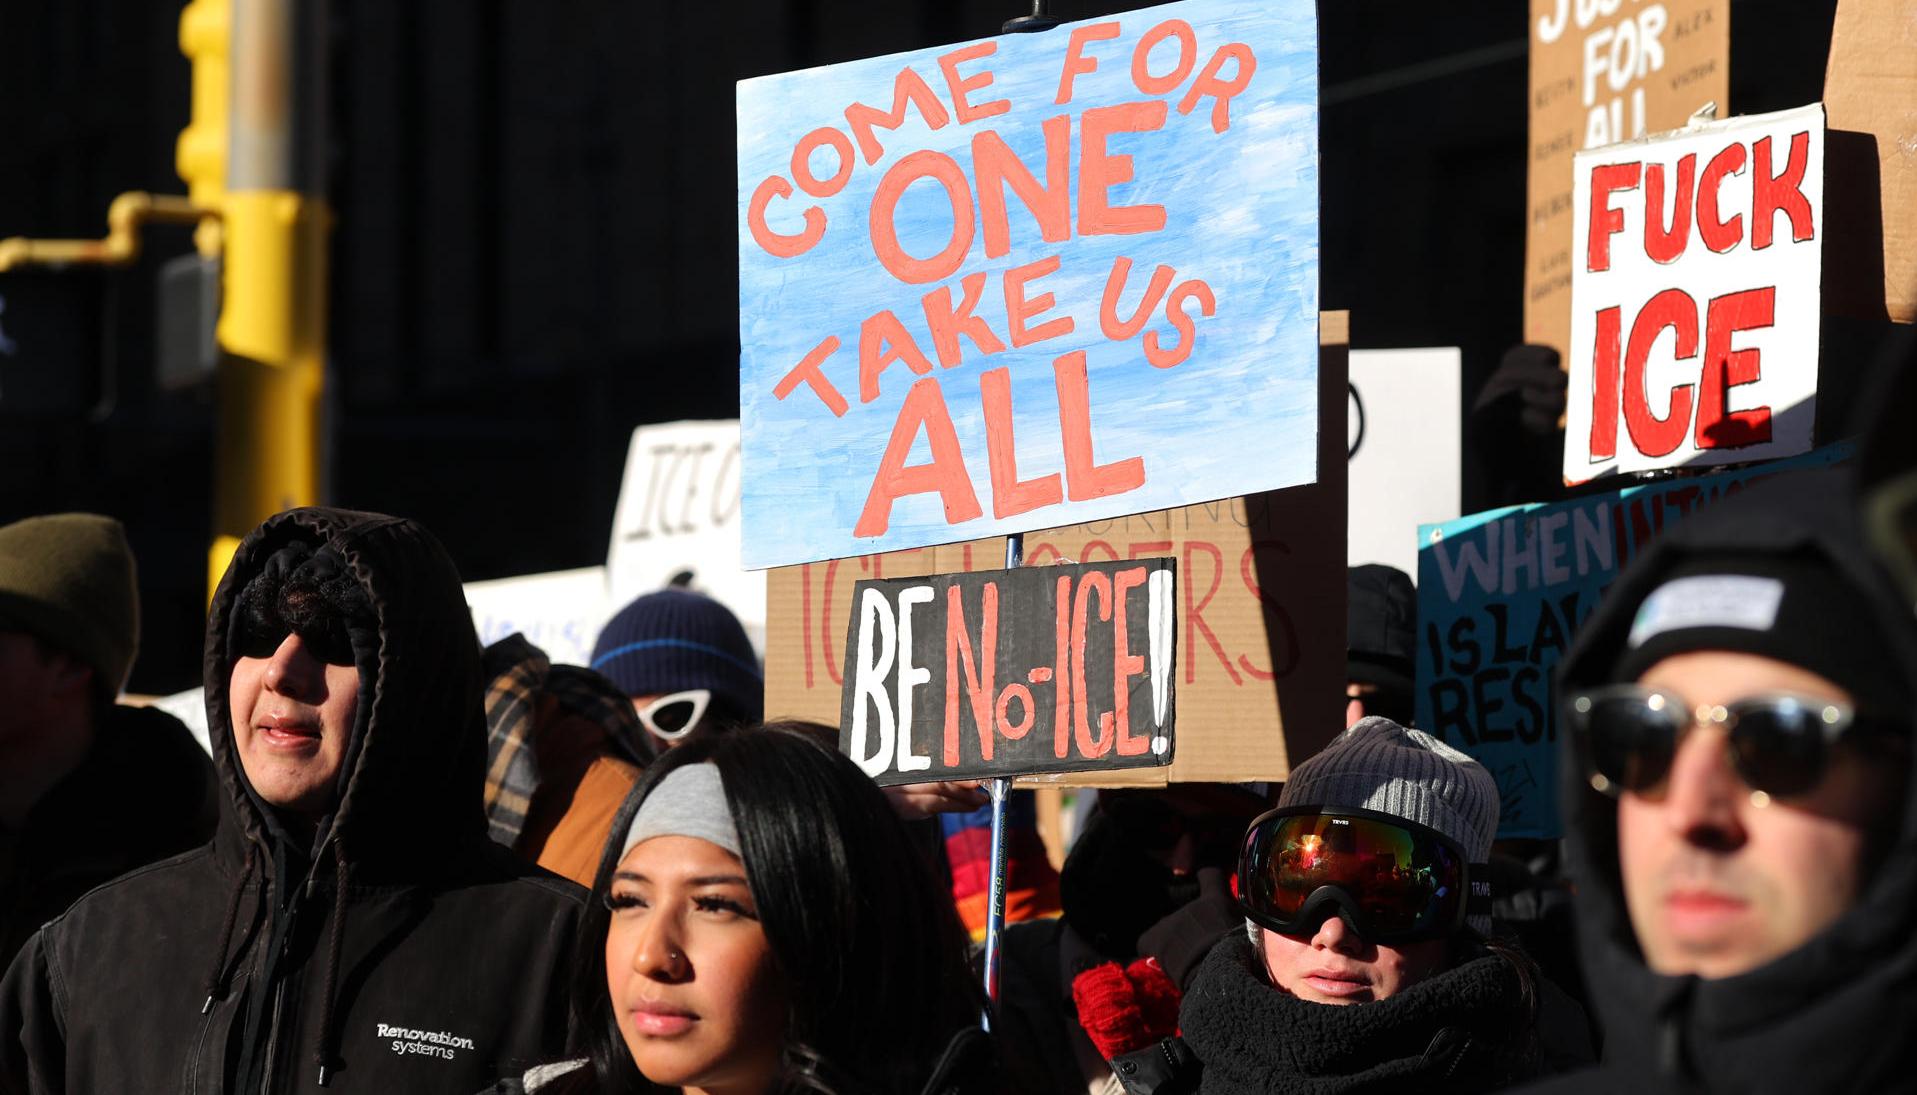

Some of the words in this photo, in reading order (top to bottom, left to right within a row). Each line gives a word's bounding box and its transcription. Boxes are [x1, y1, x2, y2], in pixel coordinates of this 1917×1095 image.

[1583, 5, 1667, 107] FOR
[747, 41, 1011, 258] COME
[1054, 19, 1257, 134] FOR
[869, 100, 1168, 284] ONE
[1587, 131, 1815, 273] FUCK
[772, 255, 1075, 418] TAKE
[1099, 256, 1216, 369] US
[1590, 285, 1776, 464] ICE
[853, 349, 1146, 537] ALL
[1431, 502, 1613, 603] WHEN
[849, 585, 935, 777] BE
[1427, 616, 1481, 677] IS
[392, 1040, 455, 1060] systems
